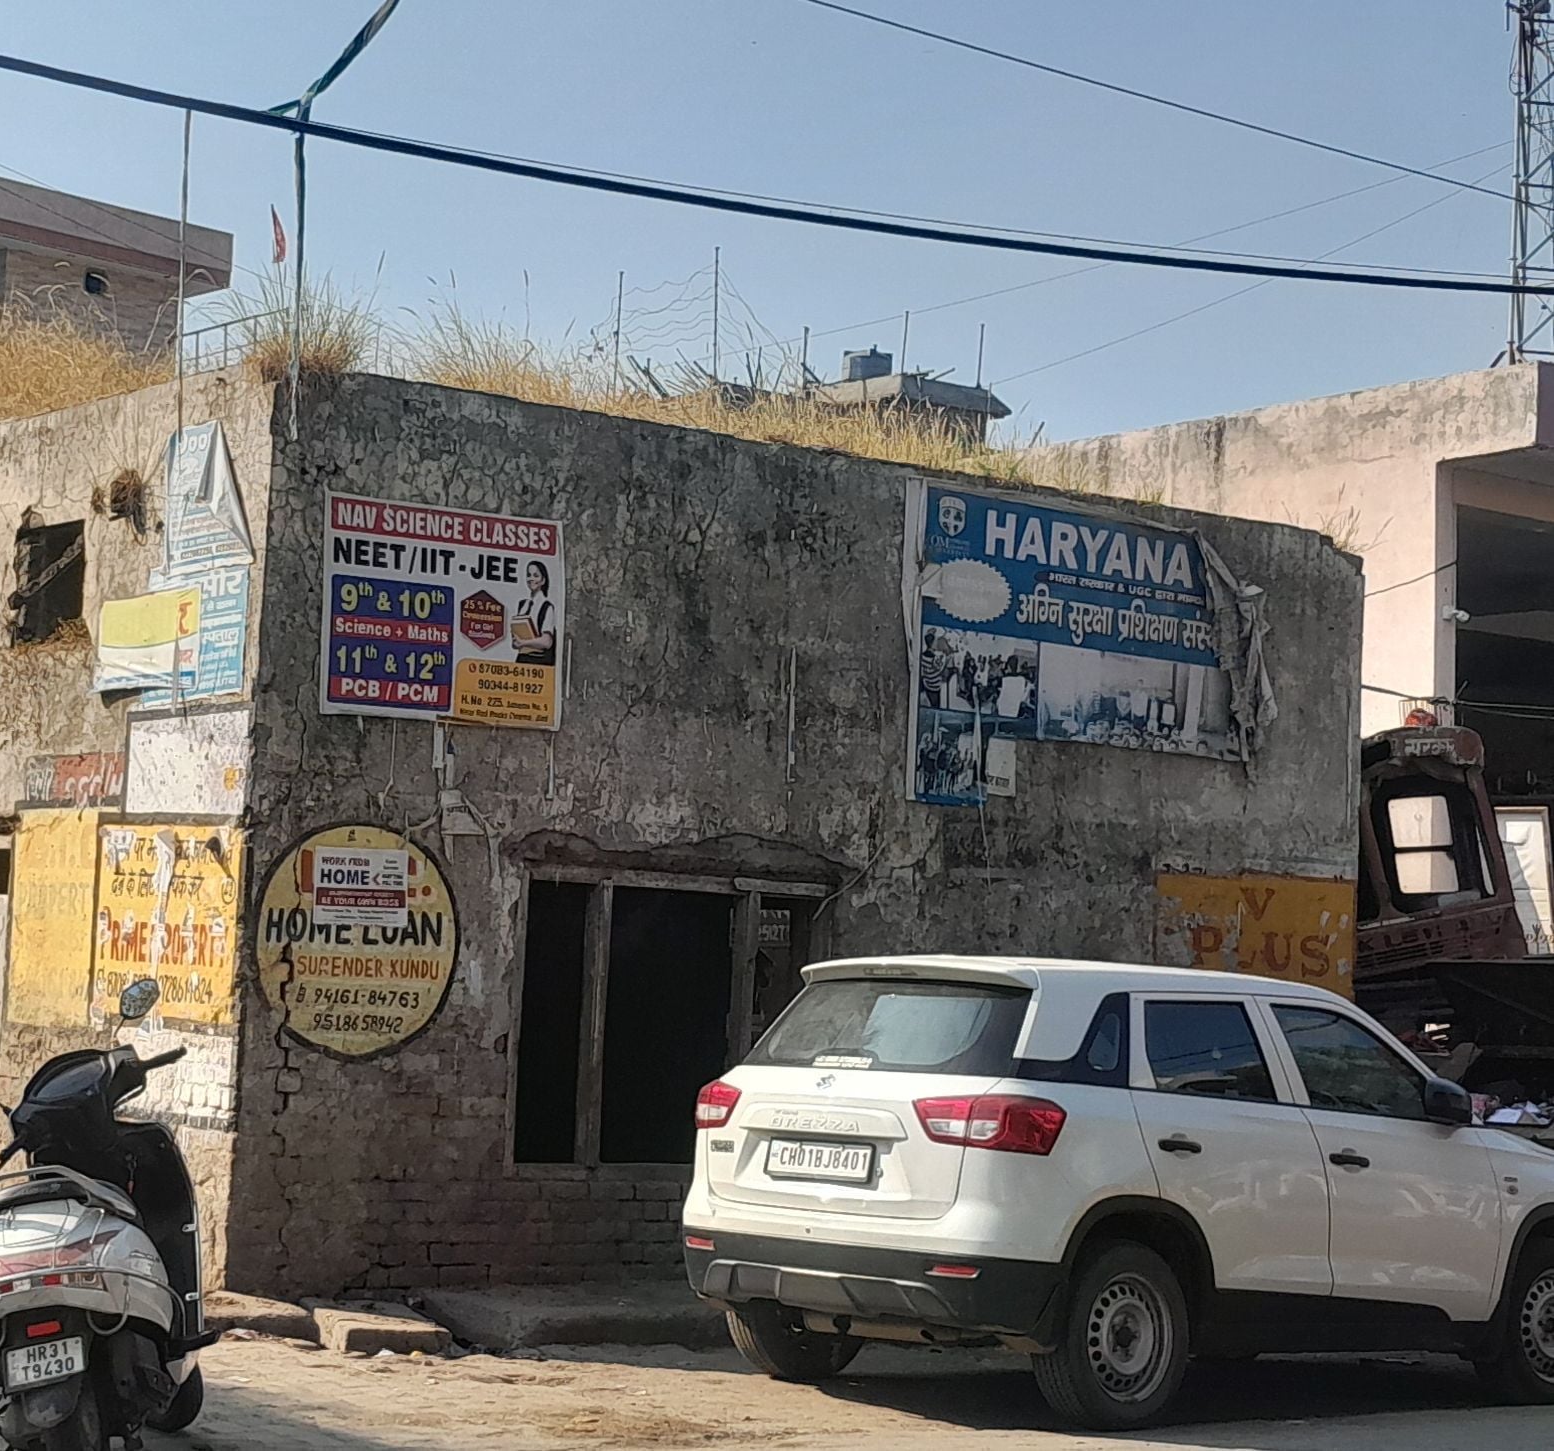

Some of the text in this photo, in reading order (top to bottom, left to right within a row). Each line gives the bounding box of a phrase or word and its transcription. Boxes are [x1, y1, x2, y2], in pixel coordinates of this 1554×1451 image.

[337, 503, 550, 550] NAV SCIENCE CLASSES
[984, 508, 1194, 589] HARYANA
[470, 554, 519, 583] JEE
[340, 583, 445, 619] 9th & 10th
[1117, 584, 1125, 593] &
[1128, 585, 1152, 598] UGC
[1016, 583, 1064, 628] अग्नि
[1068, 600, 1114, 645] सुरक्षा
[1118, 599, 1179, 646] प्रशिक्षण
[335, 619, 449, 642] Science + Maths
[336, 645, 446, 680] 11th & 12th
[340, 679, 380, 697] PCB
[397, 684, 439, 702] PCM
[478, 679, 544, 694] 90344-81927
[322, 856, 346, 866] WORK
[320, 868, 370, 886] HOME
[1240, 887, 1275, 921] V
[297, 955, 383, 978] SURENDER
[314, 987, 419, 1009] 94161-84763
[769, 1114, 860, 1133] BREZZA
[779, 1146, 868, 1170] CH01BJ8401
[26, 1341, 70, 1364] HR31
